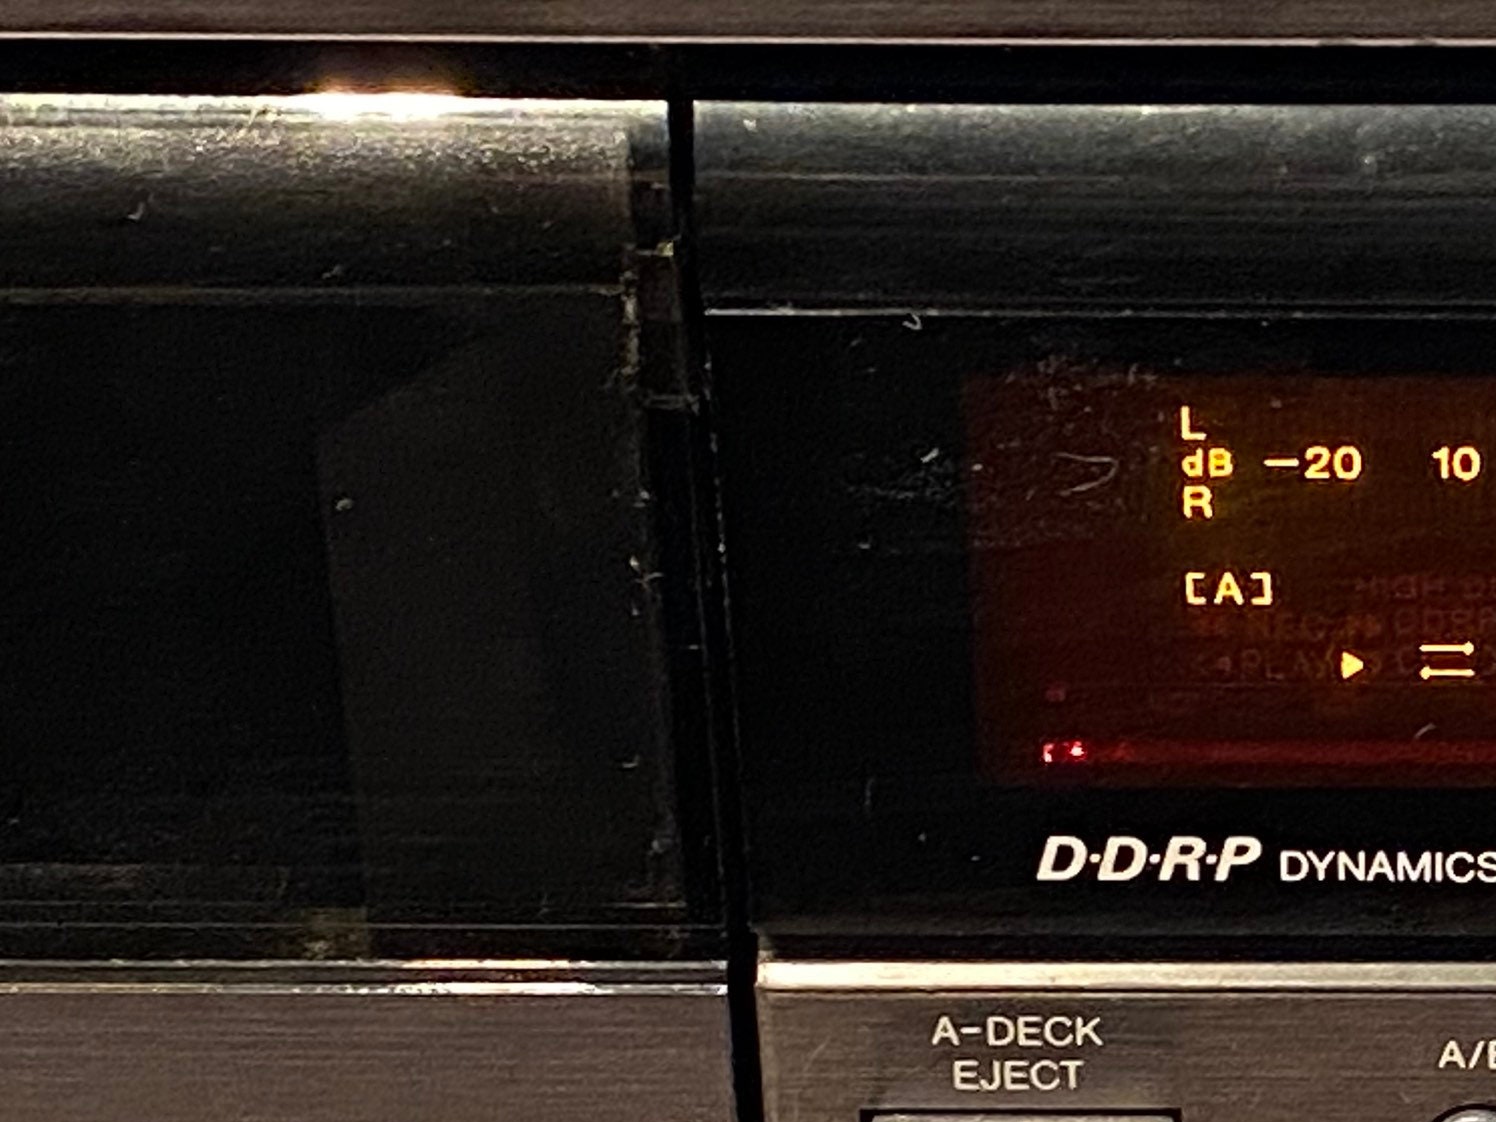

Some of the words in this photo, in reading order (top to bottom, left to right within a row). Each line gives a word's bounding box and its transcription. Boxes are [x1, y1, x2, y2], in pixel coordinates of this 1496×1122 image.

[1180, 405, 1207, 441] L
[1181, 447, 1234, 478] dB
[1431, 445, 1481, 482] 10
[1182, 485, 1213, 519] R
[931, 1016, 1103, 1047] A-DECK
[953, 1060, 1084, 1091] EJECT
